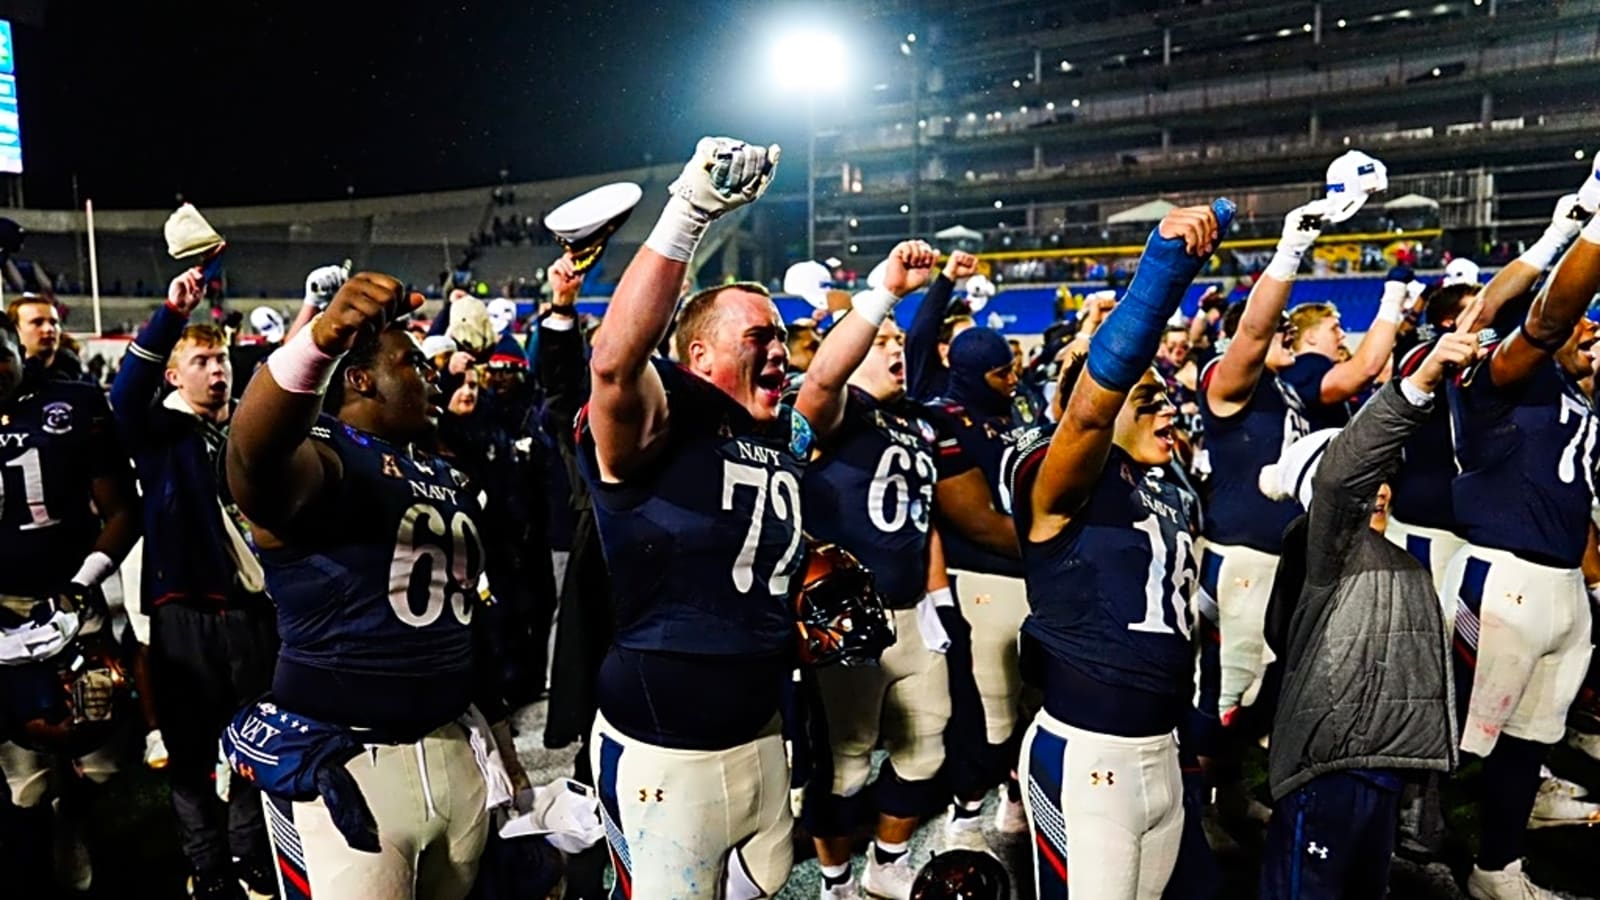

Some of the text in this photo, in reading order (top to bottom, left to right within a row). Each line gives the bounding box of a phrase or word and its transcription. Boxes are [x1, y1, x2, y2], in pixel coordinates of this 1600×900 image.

[736, 440, 781, 467] NAVY
[888, 428, 918, 449] NAVY
[0, 446, 61, 531] 1
[408, 479, 458, 506] NAVY
[867, 444, 938, 533] 63
[1138, 489, 1179, 525] NAVY
[721, 458, 802, 596] 72
[387, 502, 486, 628] 69
